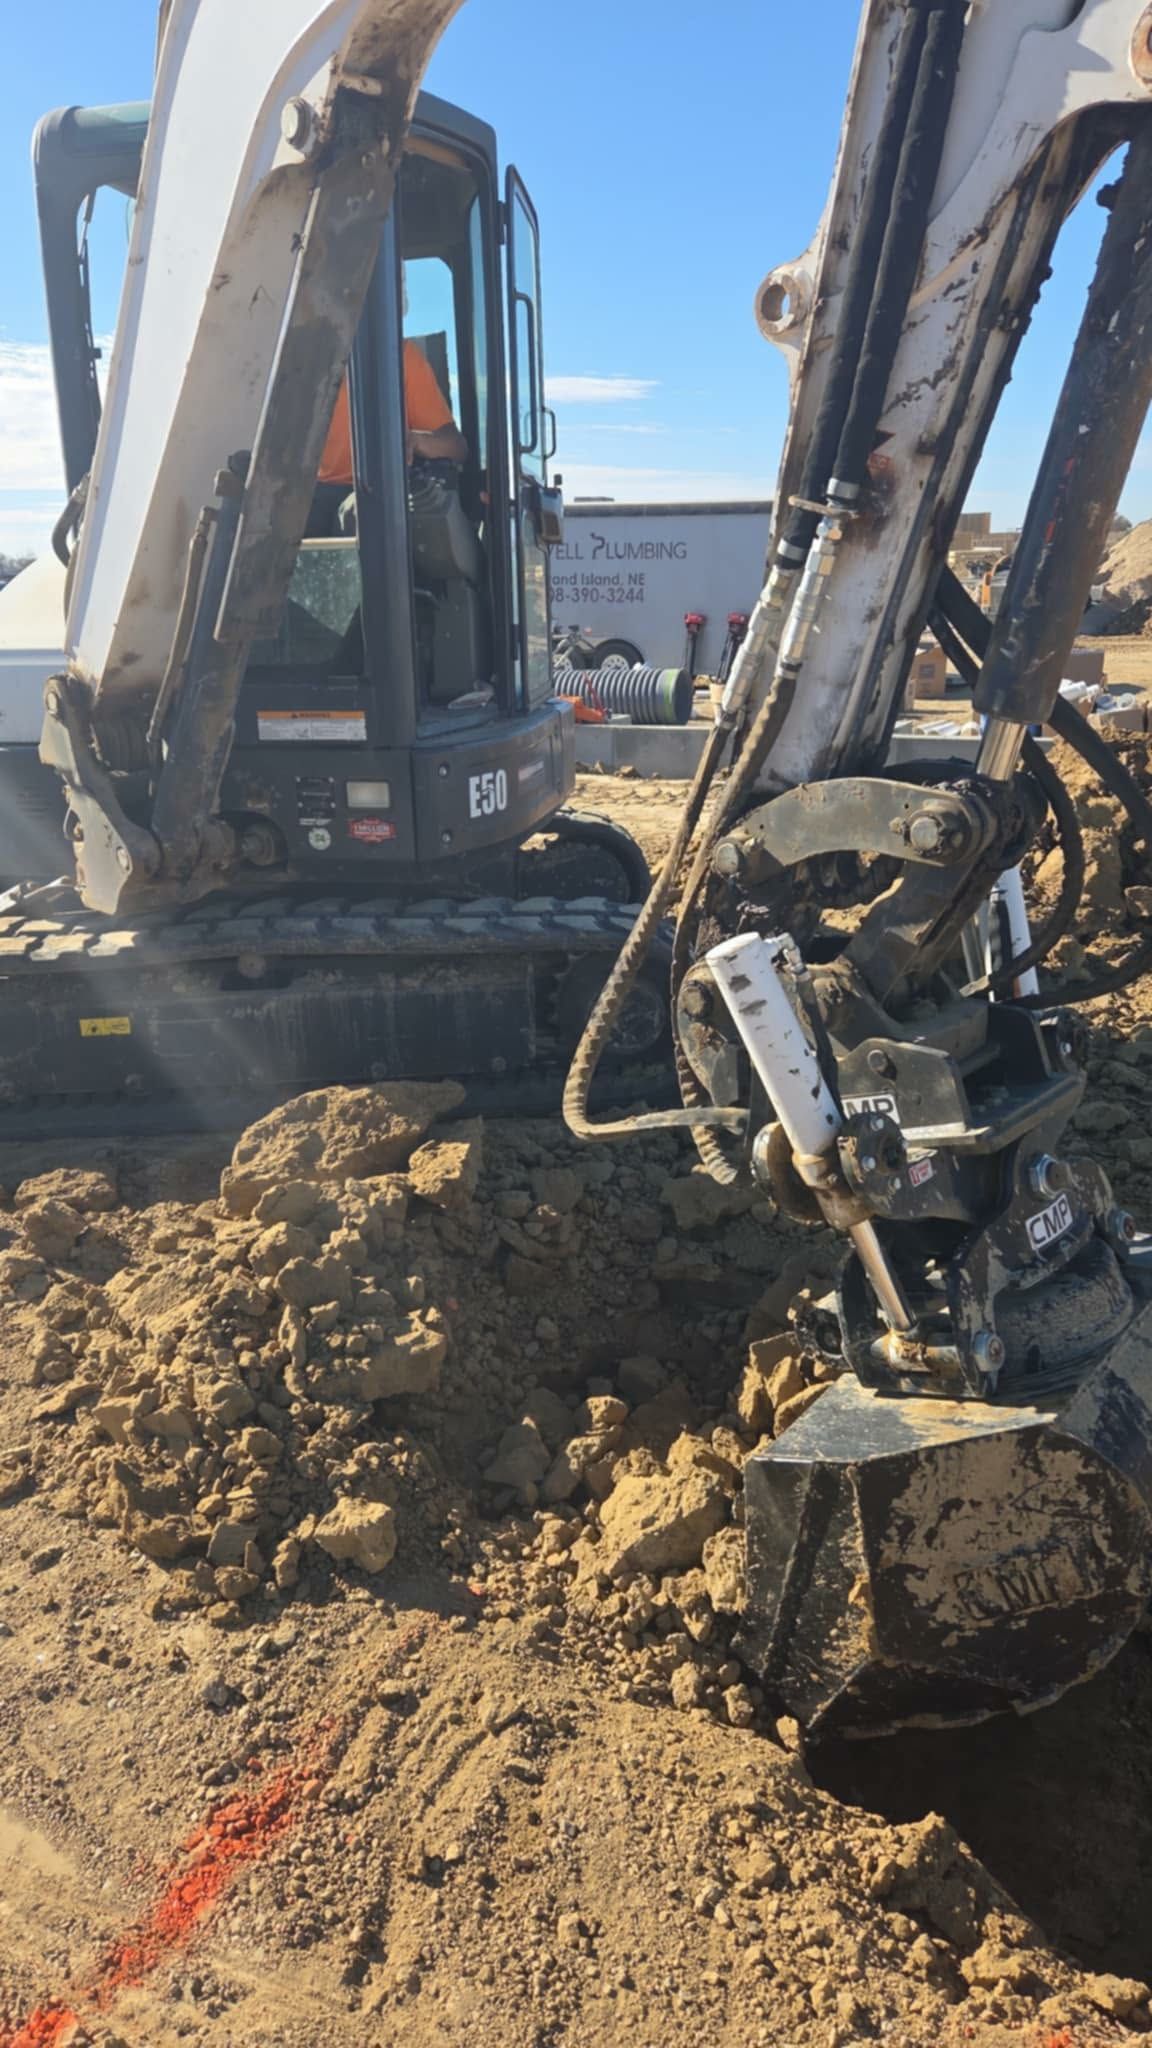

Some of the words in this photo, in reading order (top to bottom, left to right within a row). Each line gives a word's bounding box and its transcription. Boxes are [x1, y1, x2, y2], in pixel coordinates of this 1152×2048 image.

[590, 532, 687, 560] PLUMBING
[551, 573, 577, 586] and
[628, 573, 645, 586] NE
[469, 769, 508, 818] E50
[845, 1098, 894, 1117] MP
[1030, 1198, 1068, 1244] CMP
